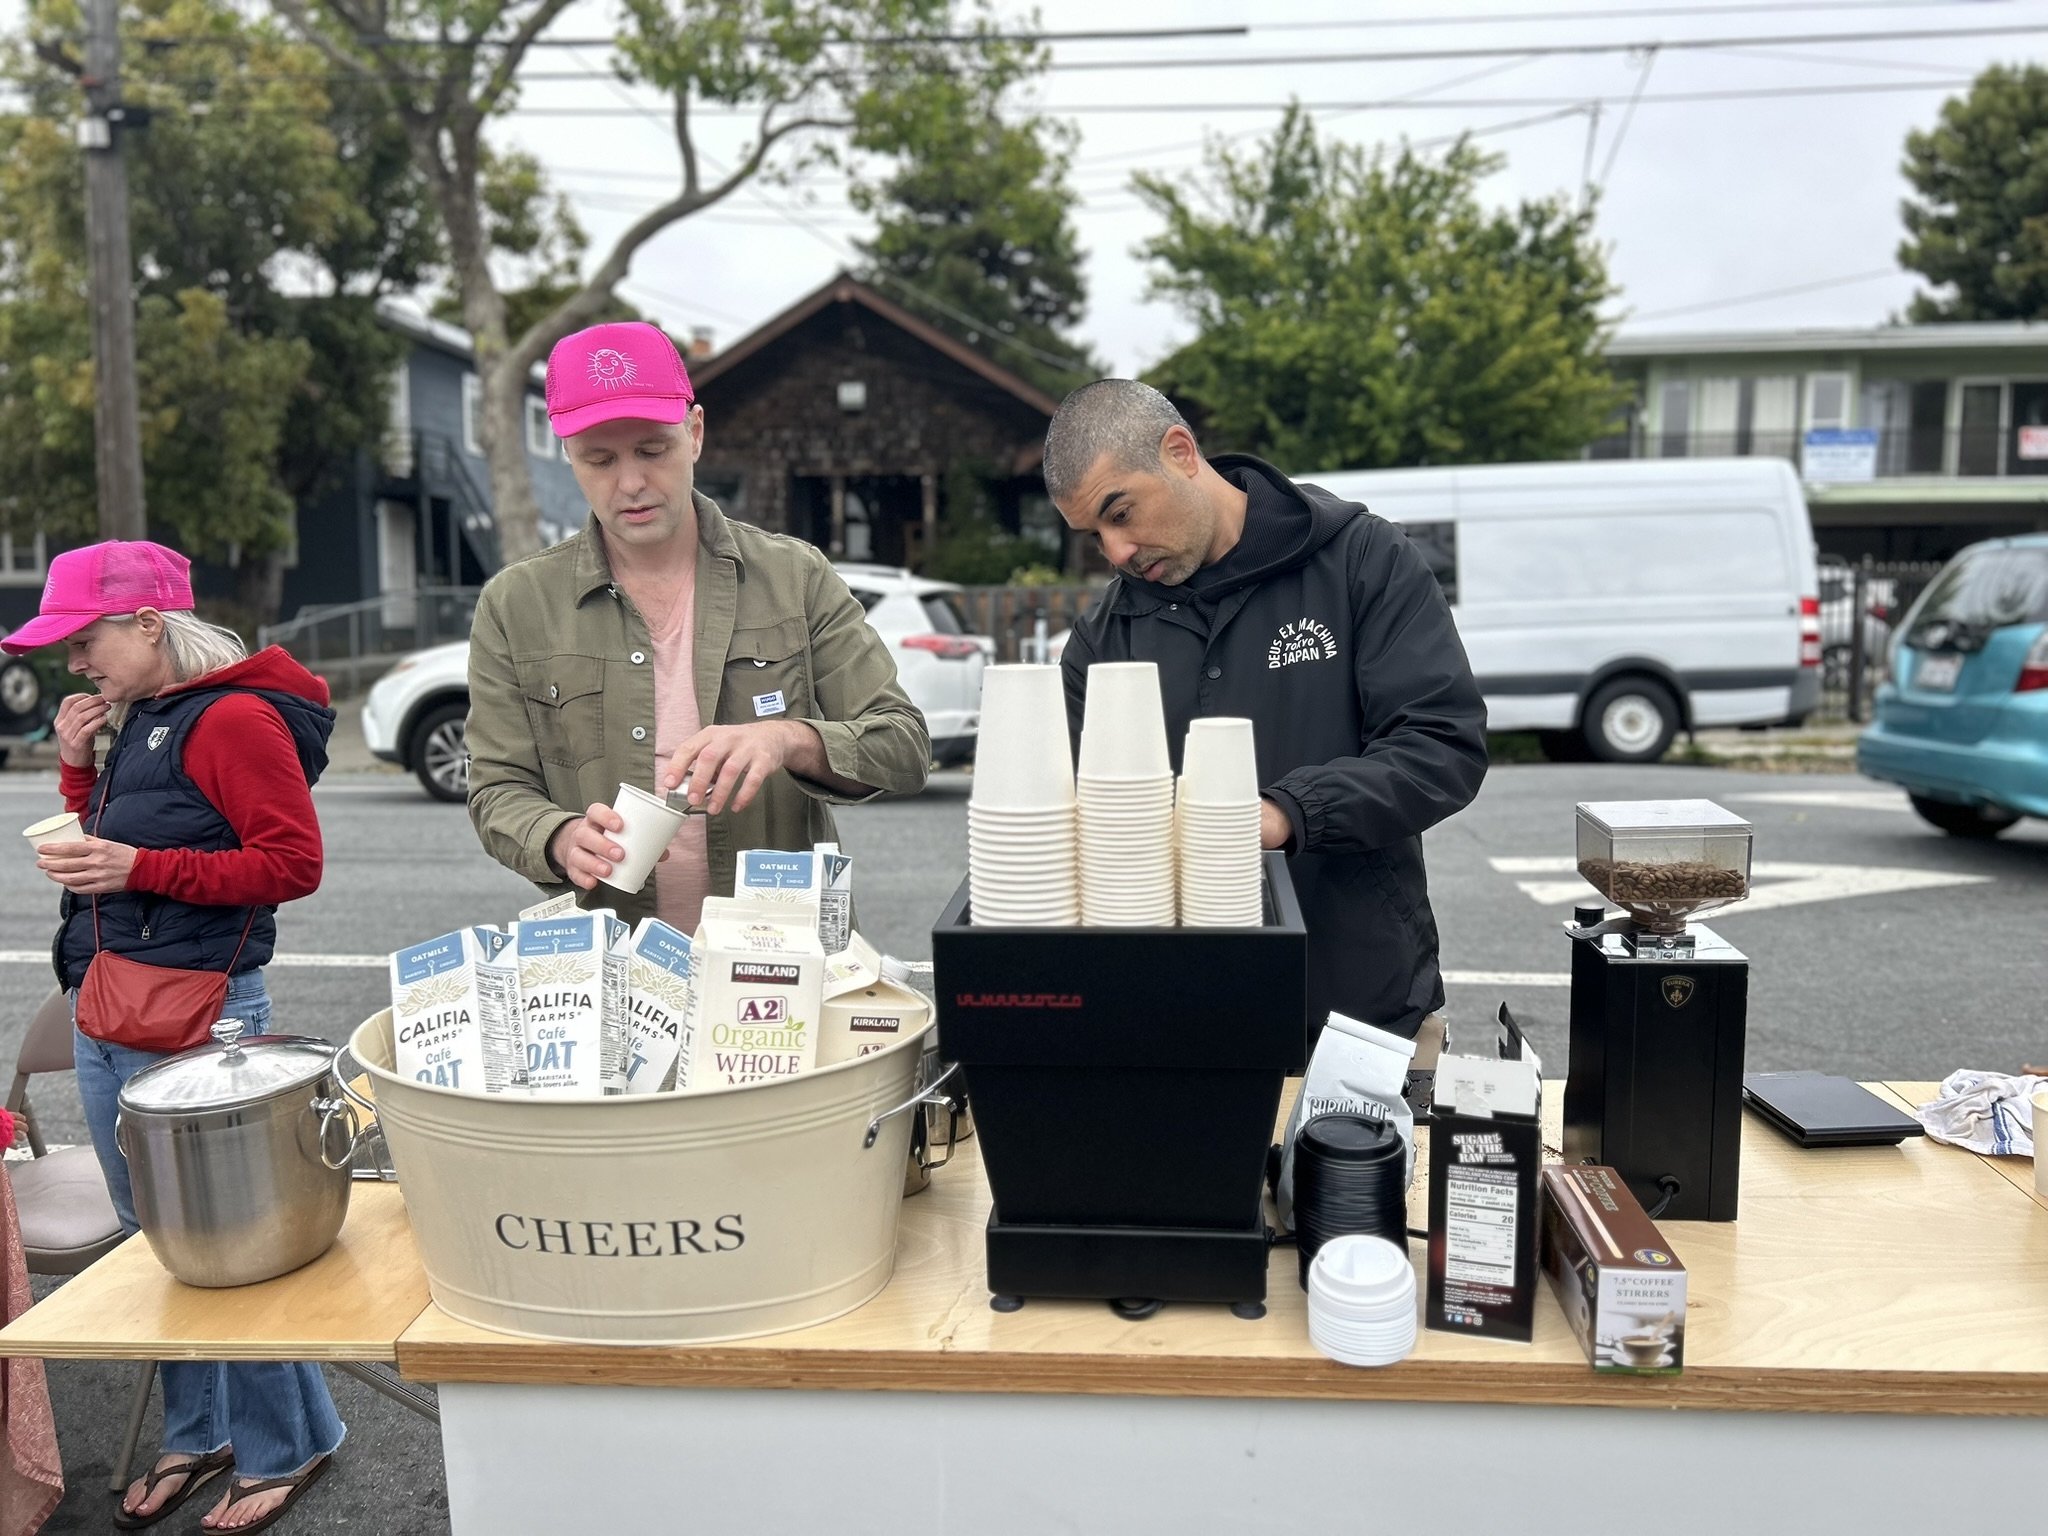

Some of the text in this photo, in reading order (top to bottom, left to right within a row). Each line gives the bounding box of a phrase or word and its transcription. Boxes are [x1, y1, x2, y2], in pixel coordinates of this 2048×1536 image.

[1268, 617, 1338, 669] DEUS EX MACHINA
[1282, 647, 1320, 666] JAPAN
[759, 863, 799, 871] OATMILK
[534, 927, 578, 938] OATMILK
[411, 945, 449, 963] OATMILK
[659, 940, 691, 961] OATMIL
[735, 964, 798, 977] KIRKLAND
[740, 1000, 779, 1021] A2
[399, 1009, 471, 1044] CALIFIA
[853, 1018, 898, 1028] KIRKLAND
[537, 1027, 567, 1040] Café
[712, 1023, 807, 1052] Organic
[425, 1047, 452, 1065] Café
[715, 1053, 801, 1075] WHOLE
[1452, 1134, 1492, 1146] SUGAR
[1461, 1144, 1503, 1154] IN THE
[1459, 1153, 1485, 1163] RAW
[1450, 1182, 1488, 1193] Nutrition
[1490, 1186, 1514, 1196] Facts
[1449, 1210, 1514, 1224] Calories 20
[495, 1213, 745, 1257] CHEERS
[1616, 1289, 1671, 1298] STIRRERS
